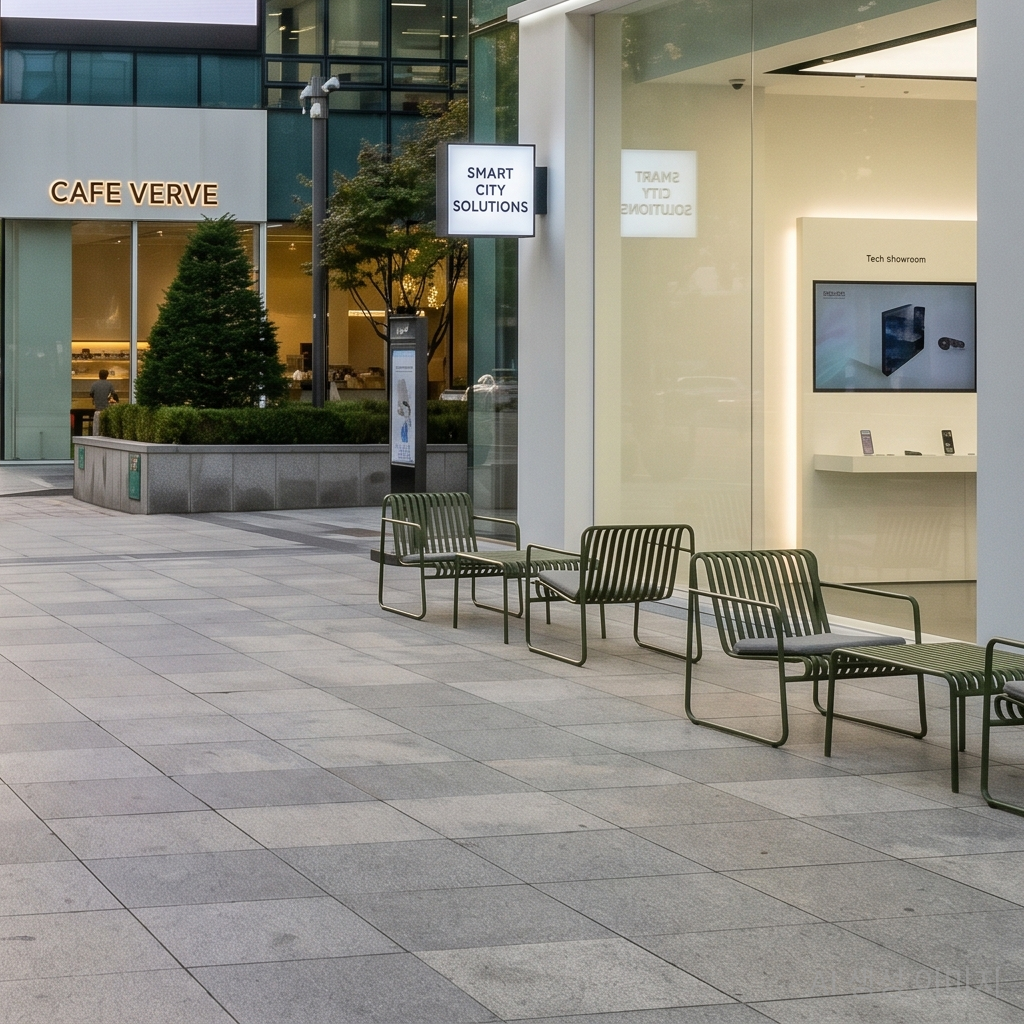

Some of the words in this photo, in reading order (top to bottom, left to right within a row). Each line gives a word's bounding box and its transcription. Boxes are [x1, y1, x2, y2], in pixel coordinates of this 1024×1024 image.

[467, 166, 514, 180] SMART
[51, 181, 121, 205] CAFE
[129, 182, 218, 206] VERVE
[475, 183, 506, 196] CITY
[452, 199, 529, 214] SOLUTIONS
[866, 254, 885, 263] Tech
[886, 254, 927, 264] showroom
